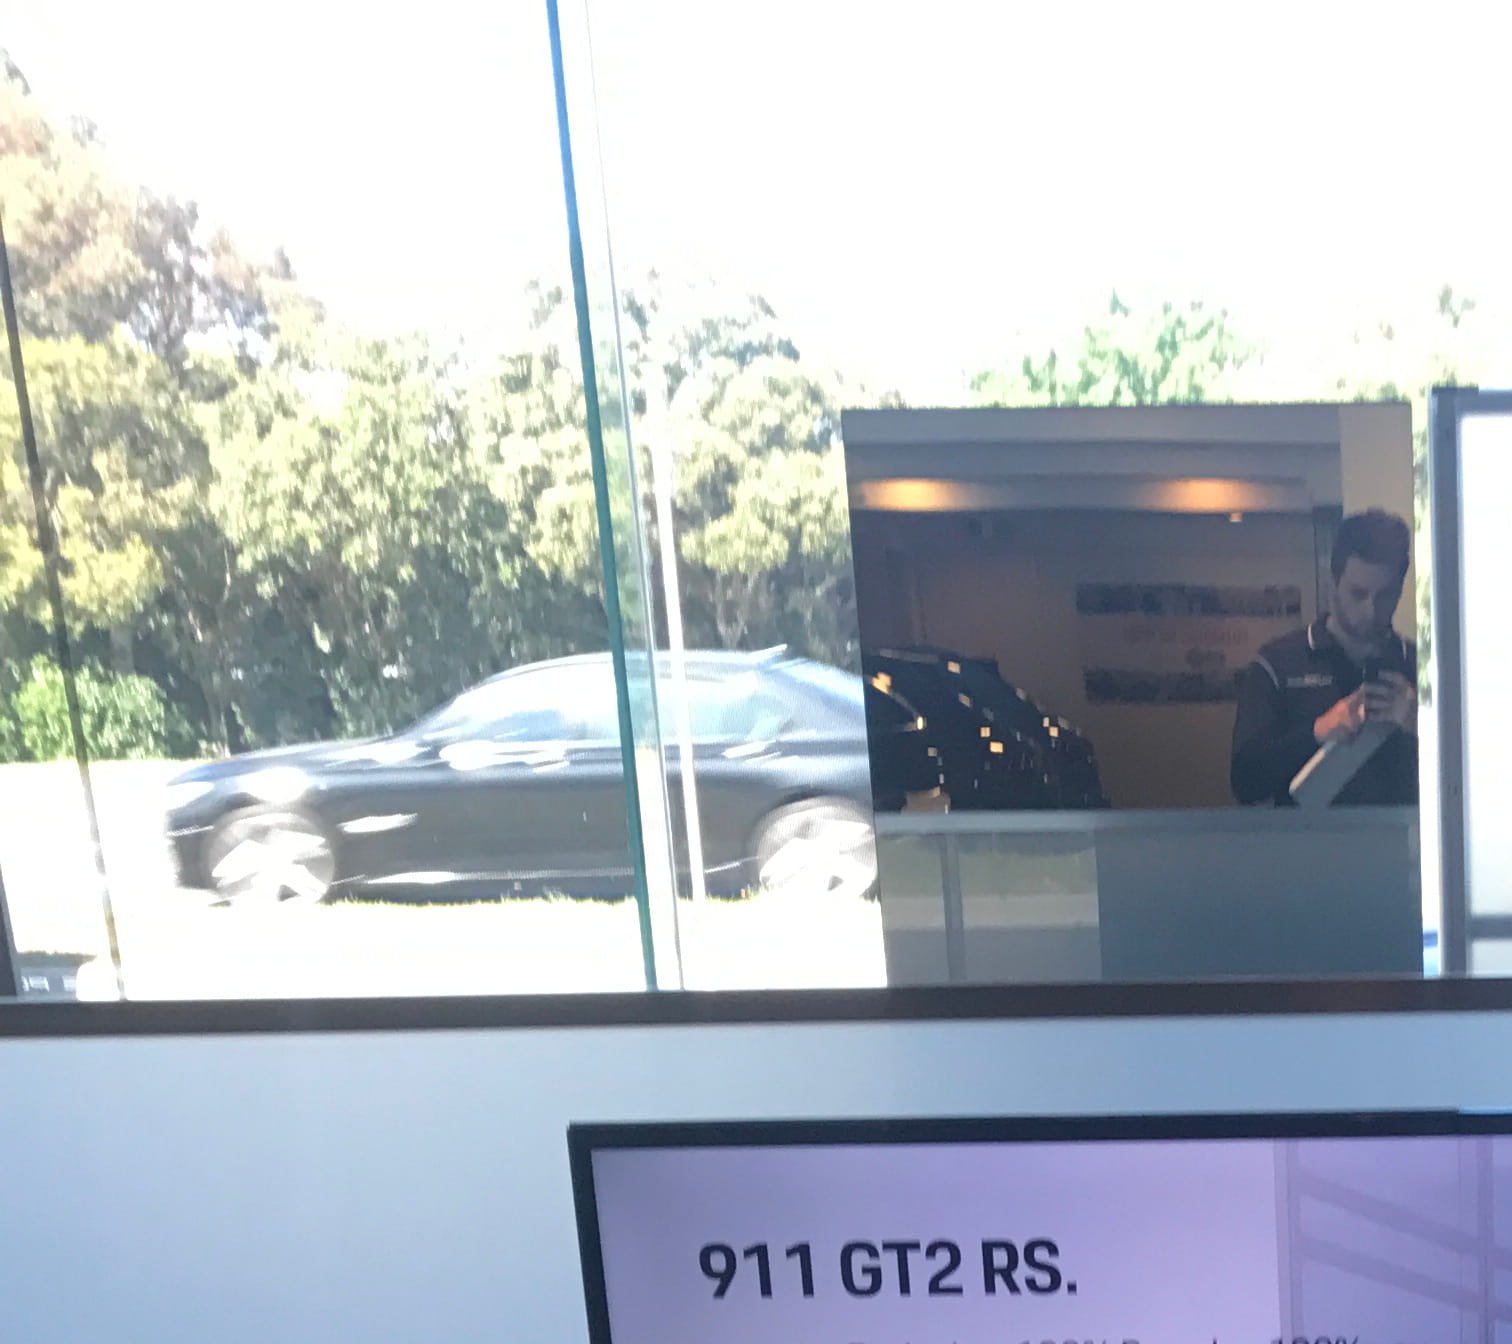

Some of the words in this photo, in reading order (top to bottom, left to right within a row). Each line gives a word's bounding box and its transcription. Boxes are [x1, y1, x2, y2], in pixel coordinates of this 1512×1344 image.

[699, 1241, 815, 1299] 911
[840, 1239, 963, 1297] GT2
[981, 1237, 1077, 1296] RS.
